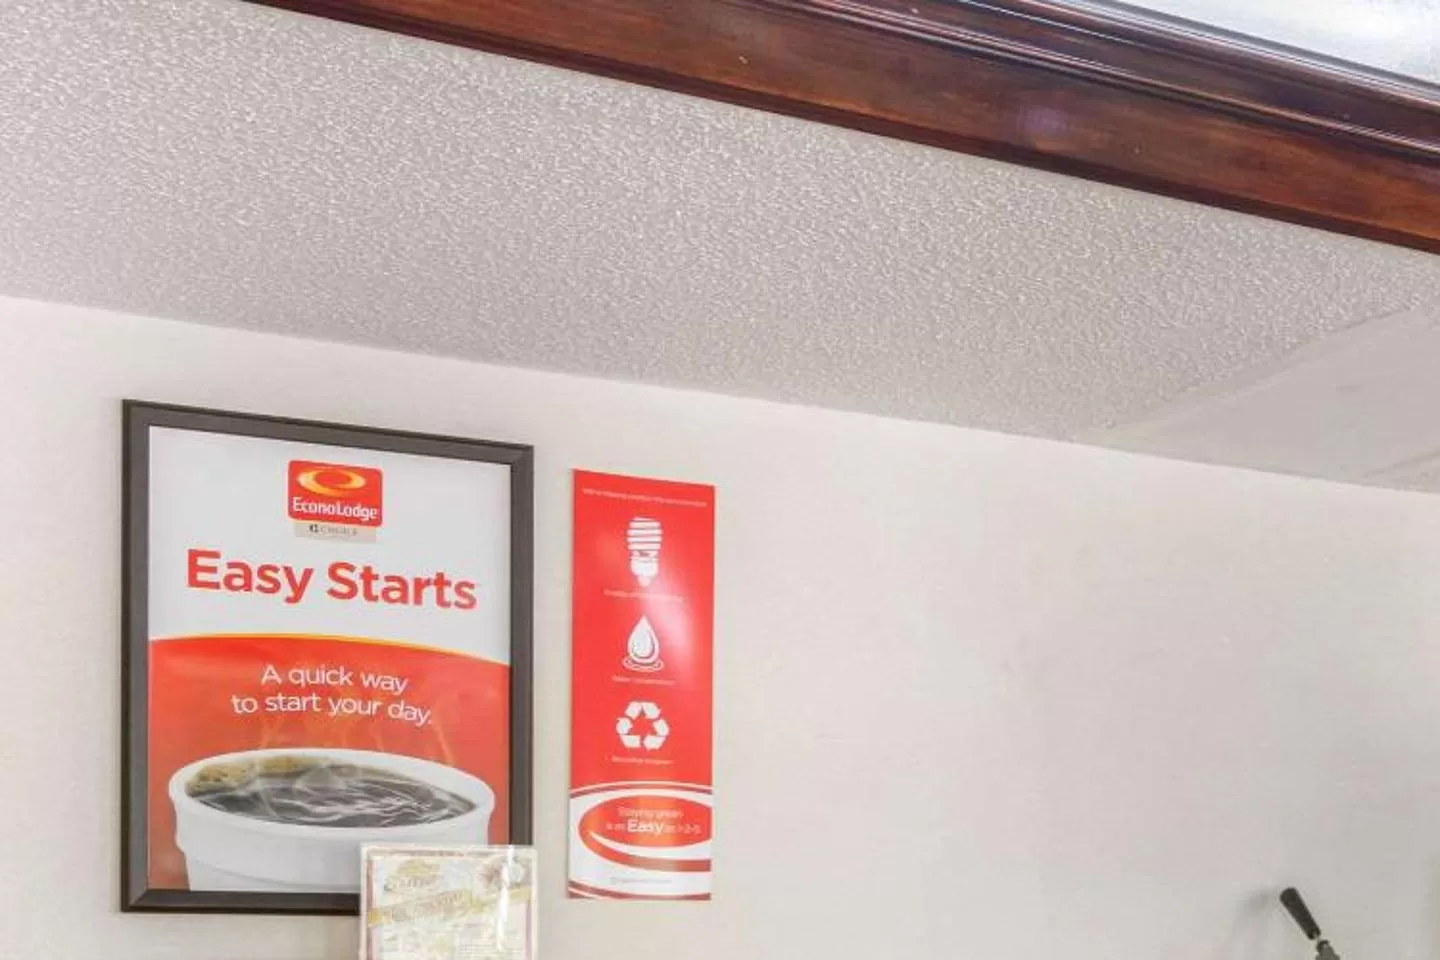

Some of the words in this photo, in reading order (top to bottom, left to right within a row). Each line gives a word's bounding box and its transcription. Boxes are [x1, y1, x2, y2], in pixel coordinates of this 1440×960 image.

[186, 549, 314, 603] Easy
[327, 561, 477, 610] Starts
[260, 664, 281, 685] A
[288, 666, 352, 690] quick
[361, 673, 408, 693] way
[231, 694, 258, 713] to
[264, 693, 320, 713] start
[328, 698, 382, 716] your
[387, 701, 432, 725] day.
[627, 819, 664, 837] Easy
